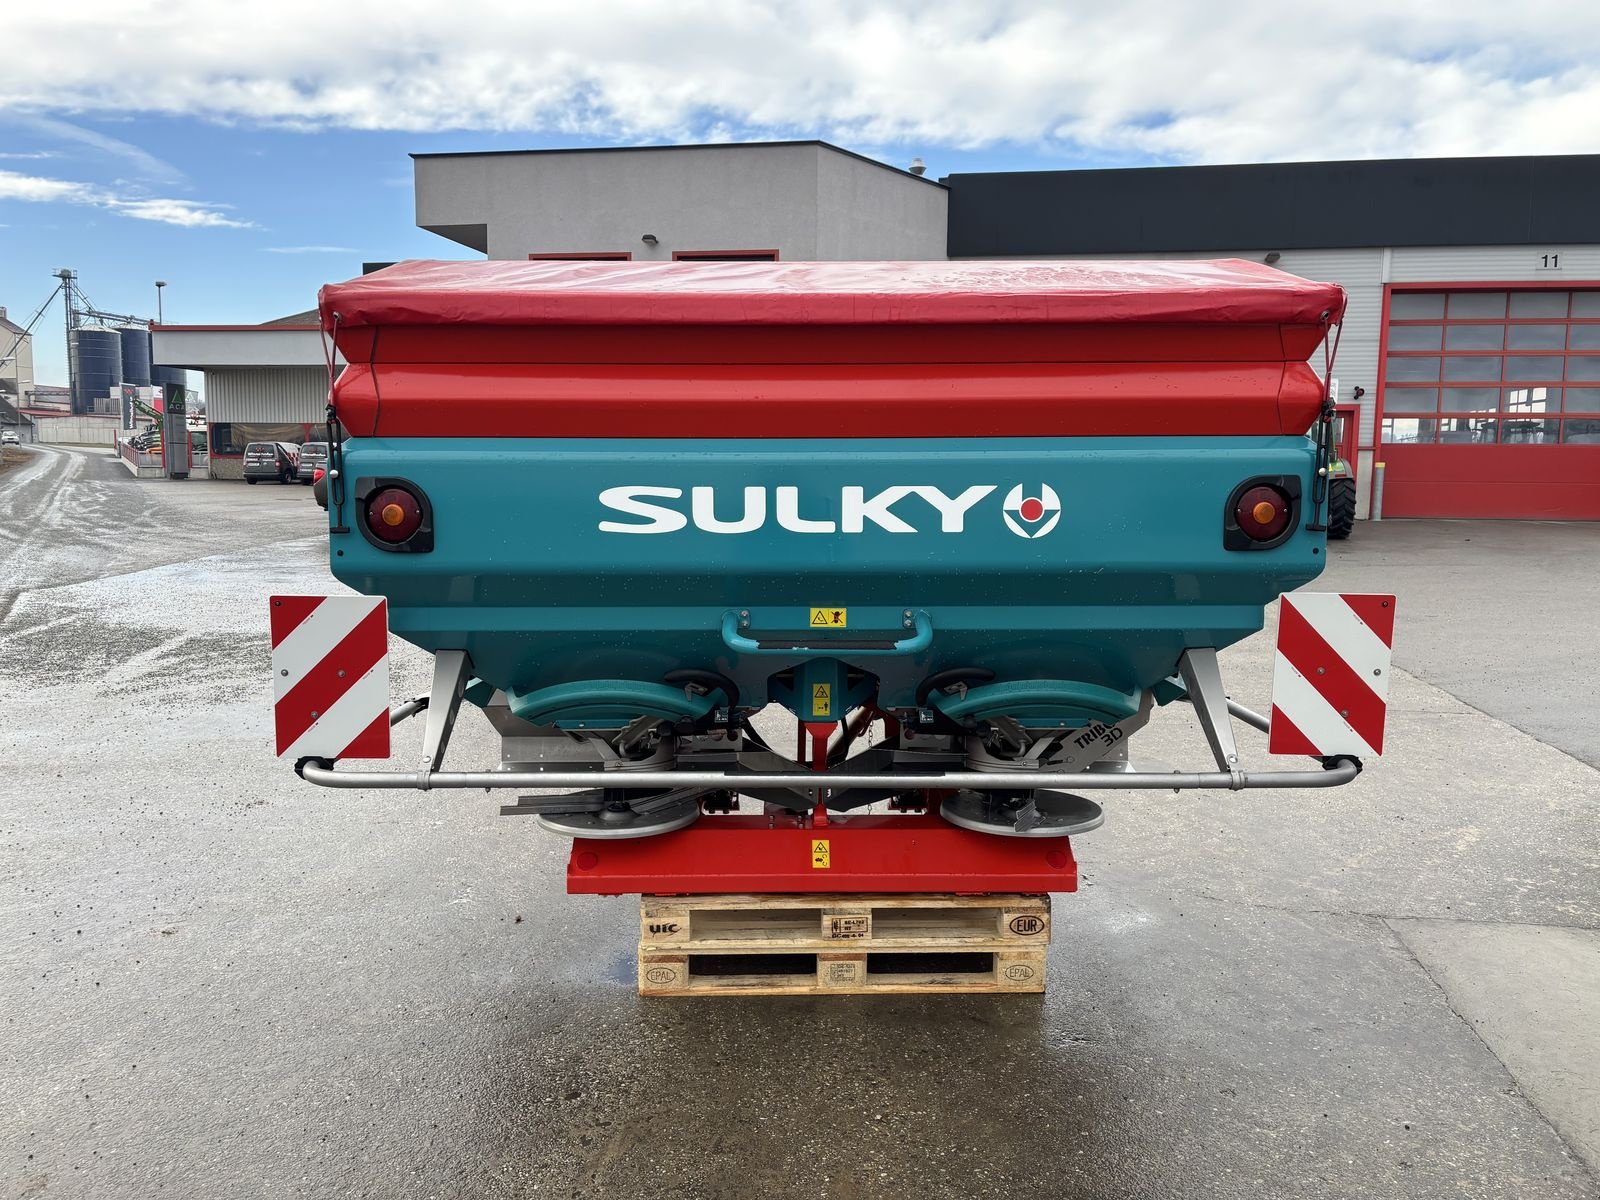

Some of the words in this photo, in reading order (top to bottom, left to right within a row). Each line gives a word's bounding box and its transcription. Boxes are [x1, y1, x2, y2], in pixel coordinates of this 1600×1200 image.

[1541, 254, 1558, 268] 11
[598, 485, 998, 534] SULKY
[1100, 727, 1123, 747] 3D
[1016, 919, 1037, 932] EUR
[650, 970, 671, 981] EPAL
[1009, 968, 1030, 978] EPAL
